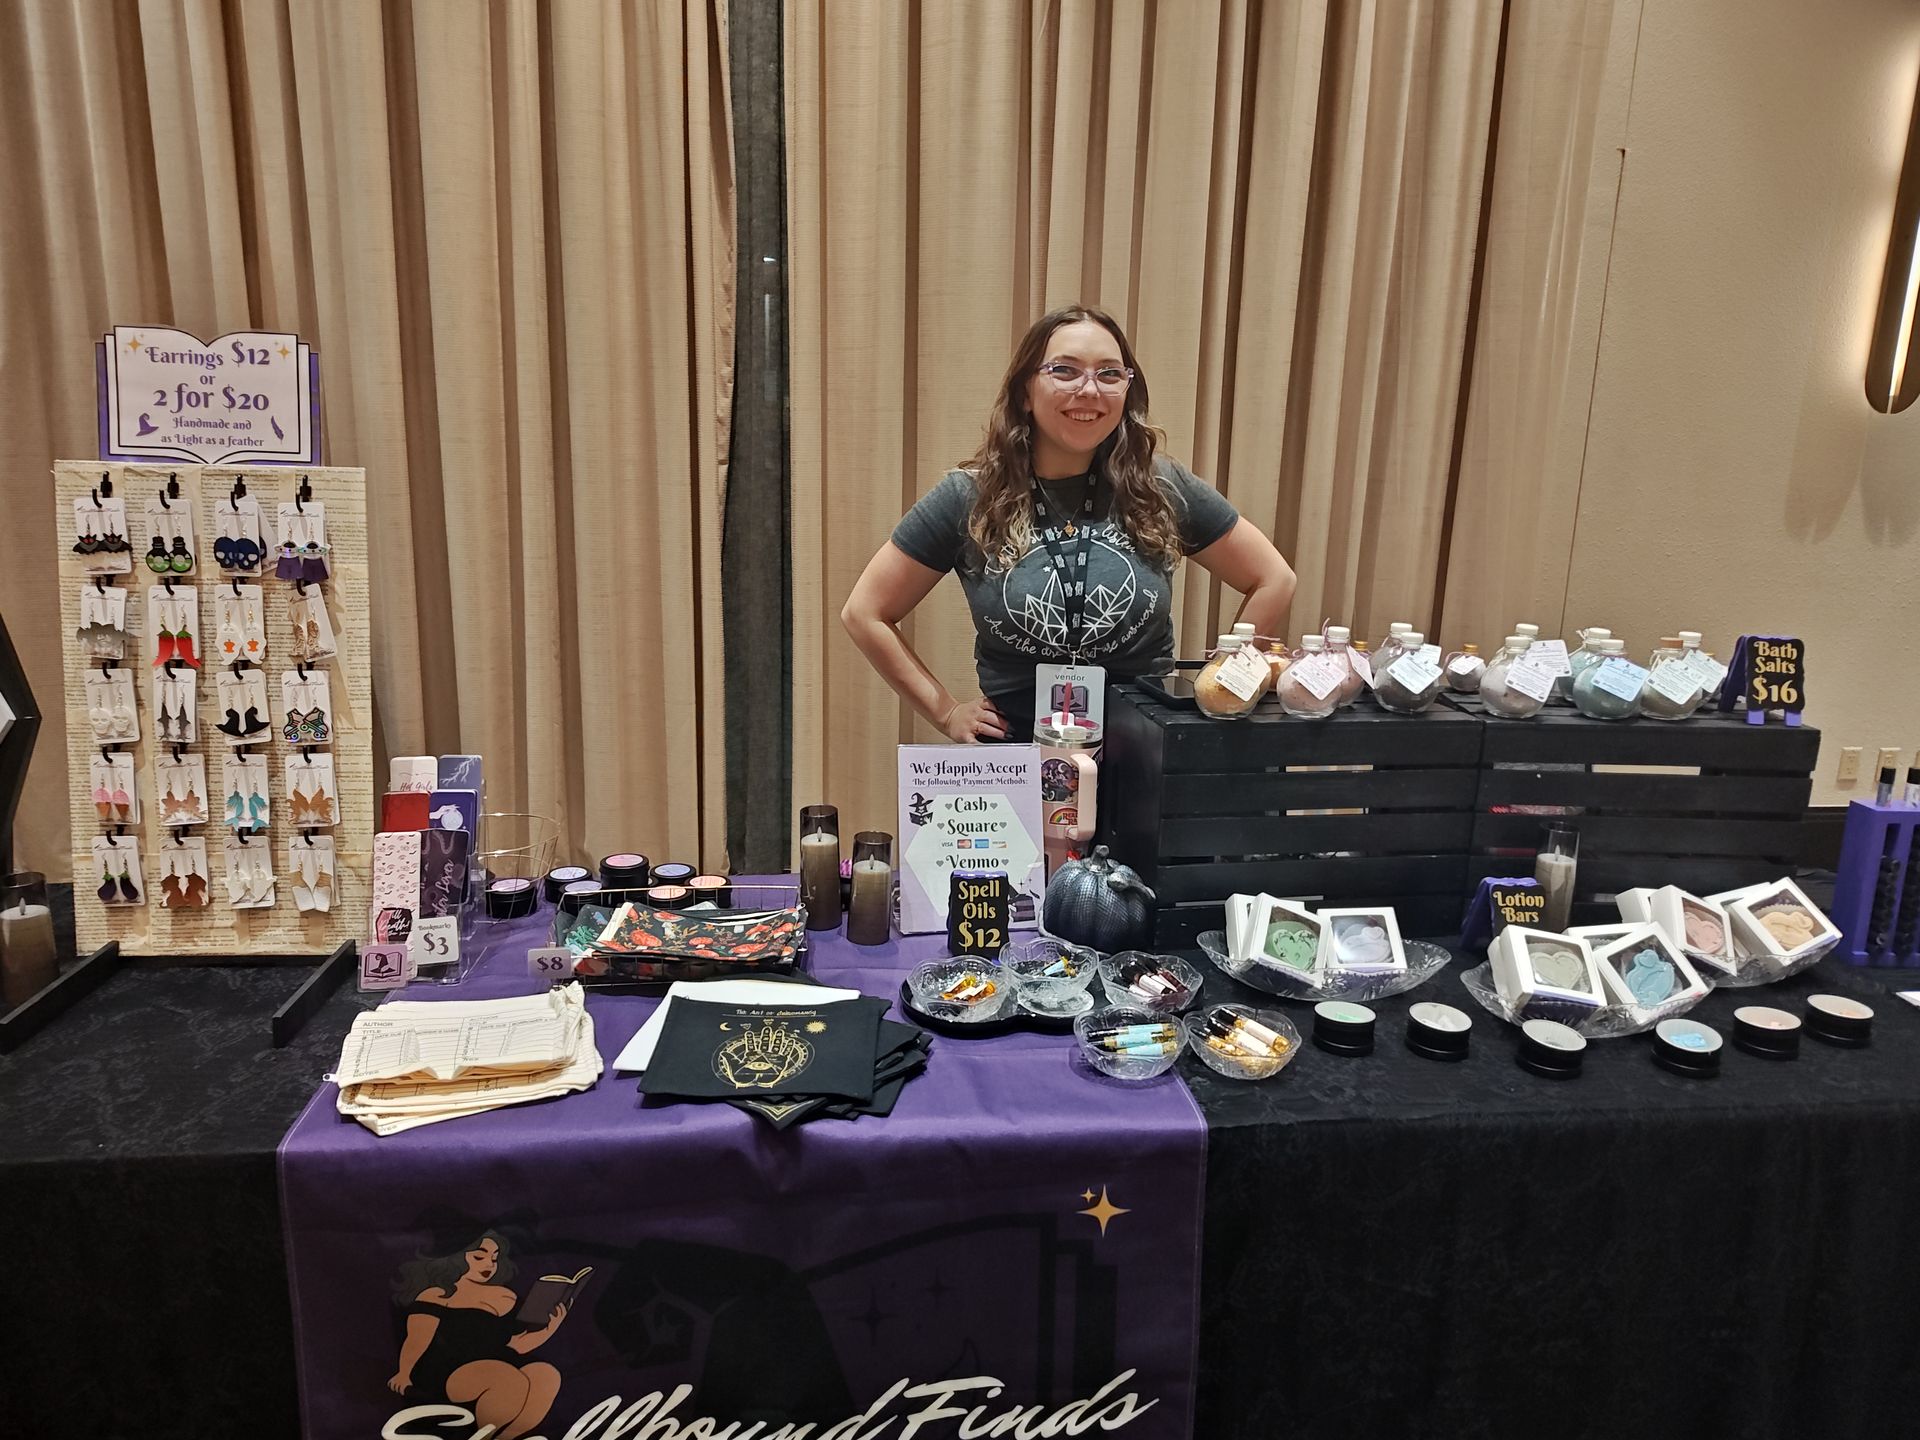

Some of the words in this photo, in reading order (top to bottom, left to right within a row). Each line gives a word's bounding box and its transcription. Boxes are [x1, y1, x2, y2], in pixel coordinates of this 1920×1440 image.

[145, 346, 224, 370] Earrings
[231, 339, 271, 367] $12
[199, 374, 216, 385] or
[153, 389, 168, 406] 2
[170, 383, 215, 413] for
[222, 384, 270, 412] $20
[173, 416, 230, 429] Handmade
[233, 418, 252, 430] and
[160, 435, 172, 444] as
[174, 433, 203, 446] Light
[206, 437, 217, 445] as
[227, 435, 265, 447] feather
[1016, 637, 1037, 655] the
[1753, 641, 1798, 660] Bath
[1754, 656, 1796, 675] Salts
[1055, 673, 1086, 682] vendor
[1752, 674, 1798, 704] $16
[909, 762, 932, 774] We
[934, 760, 983, 776] Happily
[985, 762, 1028, 776] Accept
[913, 777, 926, 786] The
[927, 777, 961, 787] following
[962, 778, 994, 787] Payment
[995, 777, 1029, 786] Methods:
[954, 796, 988, 812] Cash
[947, 819, 999, 836] Square
[946, 854, 1000, 870] Venmo
[958, 880, 1000, 902] Spell
[1493, 891, 1545, 908] Lotion
[963, 902, 997, 919] Oils
[1500, 907, 1539, 923] Bars
[423, 931, 449, 955] $3
[958, 919, 1001, 952] $12
[536, 956, 564, 972] $8
[898, 1368, 1160, 1440] Finds
